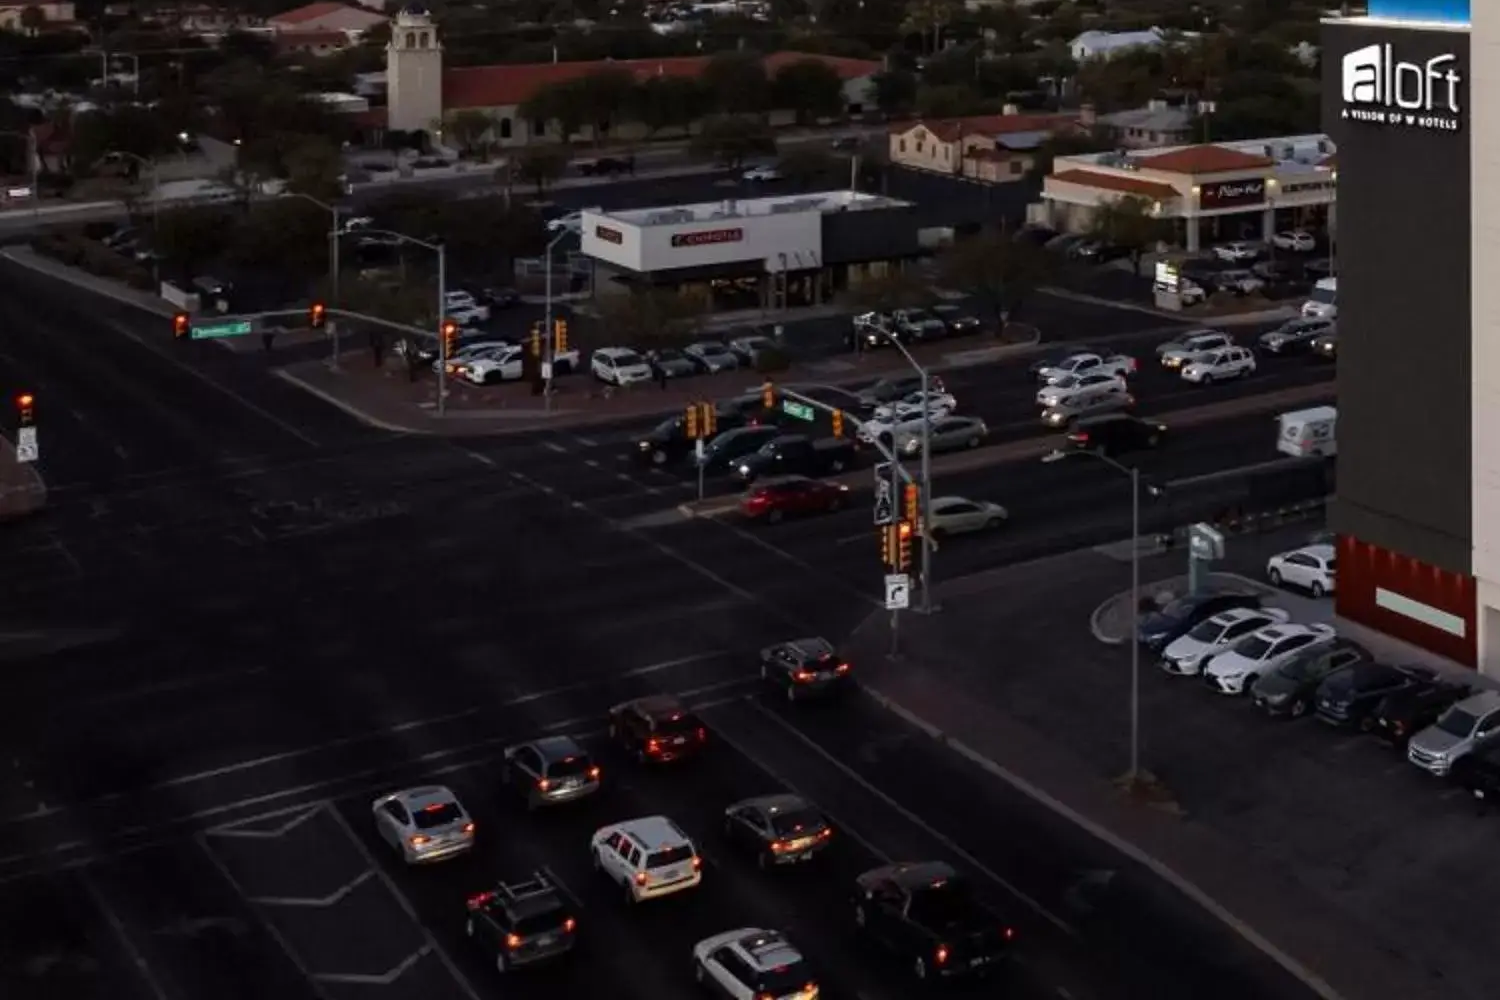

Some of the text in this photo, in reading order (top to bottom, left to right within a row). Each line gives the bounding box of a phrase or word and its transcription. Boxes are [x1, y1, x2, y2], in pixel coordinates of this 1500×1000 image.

[1342, 43, 1461, 113] aloft
[1341, 109, 1457, 129] A VISION OF W HOTELS
